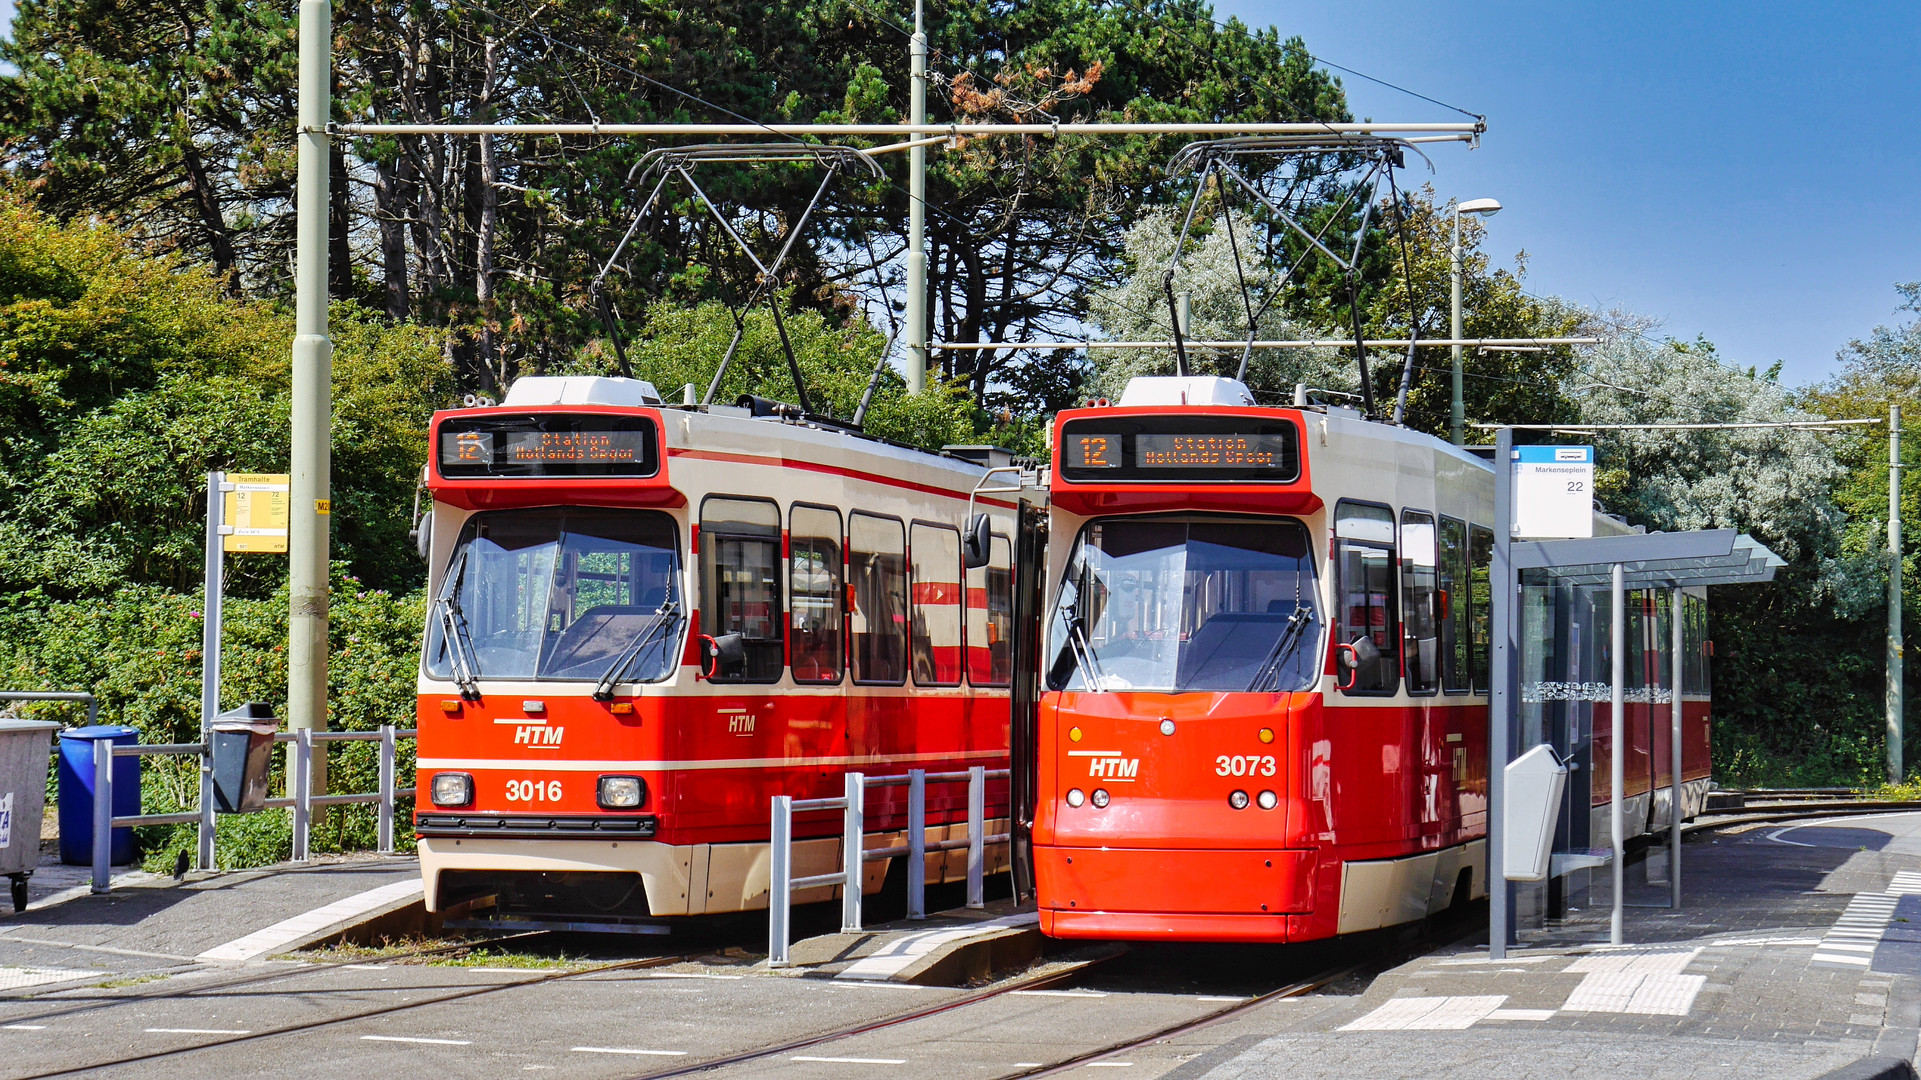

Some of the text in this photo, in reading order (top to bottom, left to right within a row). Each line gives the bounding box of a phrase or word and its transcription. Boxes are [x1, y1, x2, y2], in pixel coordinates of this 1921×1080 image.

[456, 433, 480, 460] 12
[542, 433, 610, 446] Station
[1174, 437, 1247, 450] Station
[515, 446, 634, 460] Hollands Spoor
[1080, 437, 1107, 465] 12
[1146, 451, 1273, 464] Hollands Spoor
[1535, 466, 1587, 474] Markenseplein
[1567, 481, 1584, 492] 22
[728, 715, 756, 733] HTM
[514, 726, 565, 745] HTM
[1089, 758, 1140, 777] HTM
[1215, 755, 1277, 777] 3073
[1452, 747, 1467, 782] HTM
[505, 779, 563, 802] 3016
